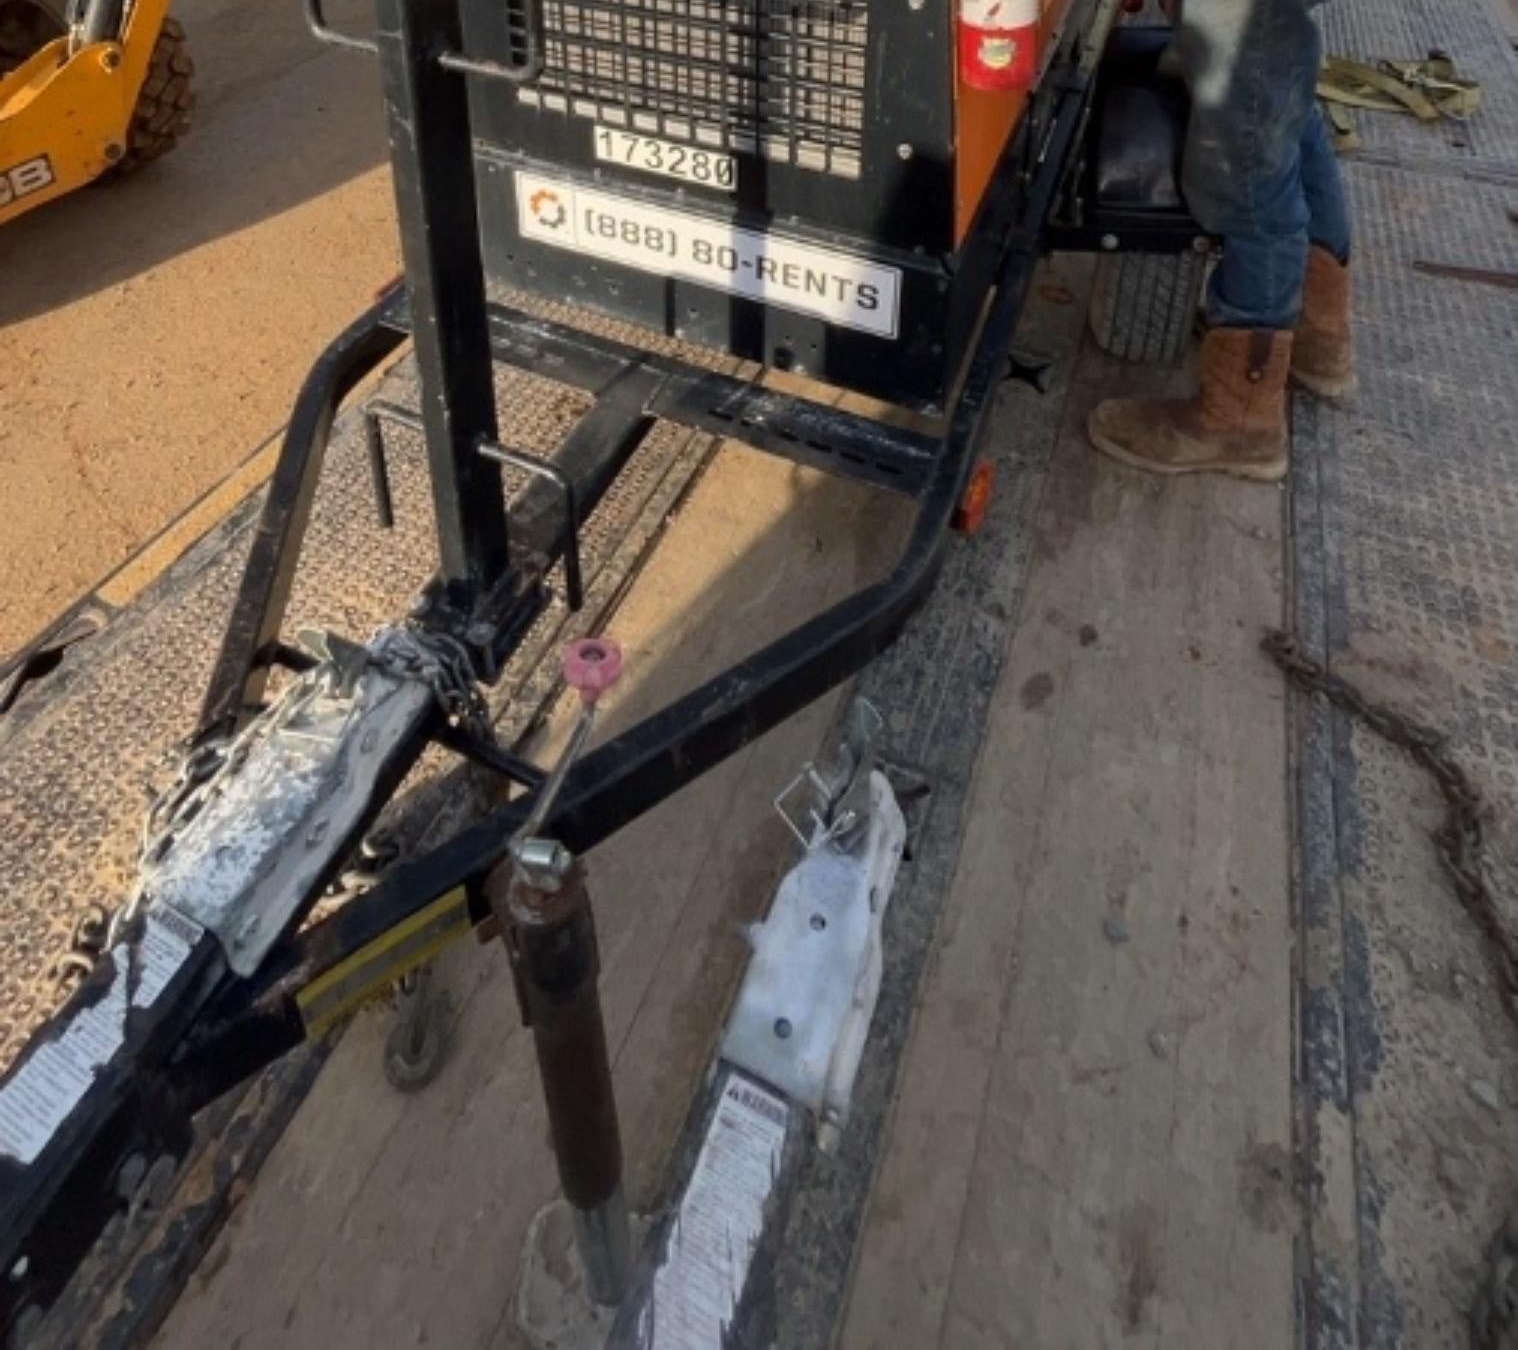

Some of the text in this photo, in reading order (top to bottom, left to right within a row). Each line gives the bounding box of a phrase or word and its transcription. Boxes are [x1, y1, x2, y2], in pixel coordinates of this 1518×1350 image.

[0, 158, 52, 204] B
[599, 130, 733, 186] 173280
[585, 208, 880, 311] (888) 80-RENTS
